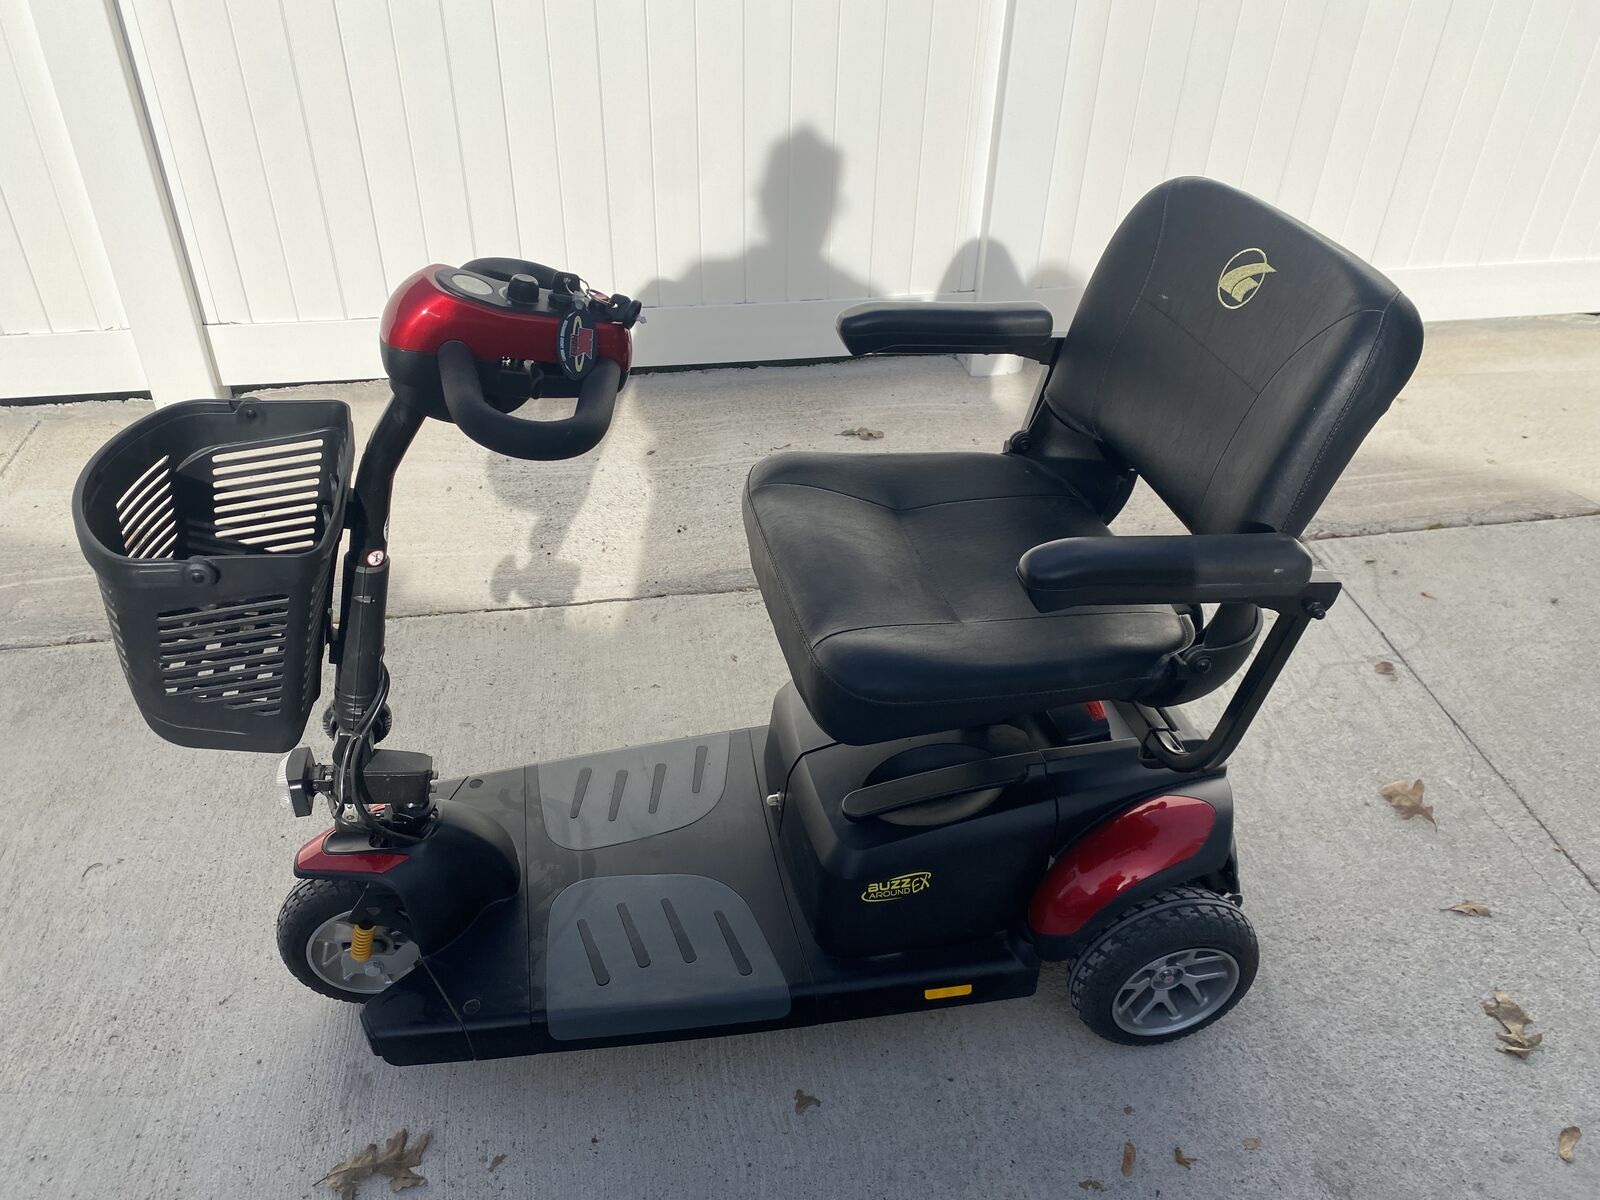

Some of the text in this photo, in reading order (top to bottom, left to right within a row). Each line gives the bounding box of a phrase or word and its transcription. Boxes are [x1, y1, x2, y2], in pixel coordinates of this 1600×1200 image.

[868, 879, 911, 893] BUZZ
[911, 874, 930, 893] EX
[869, 888, 911, 900] AROUND
